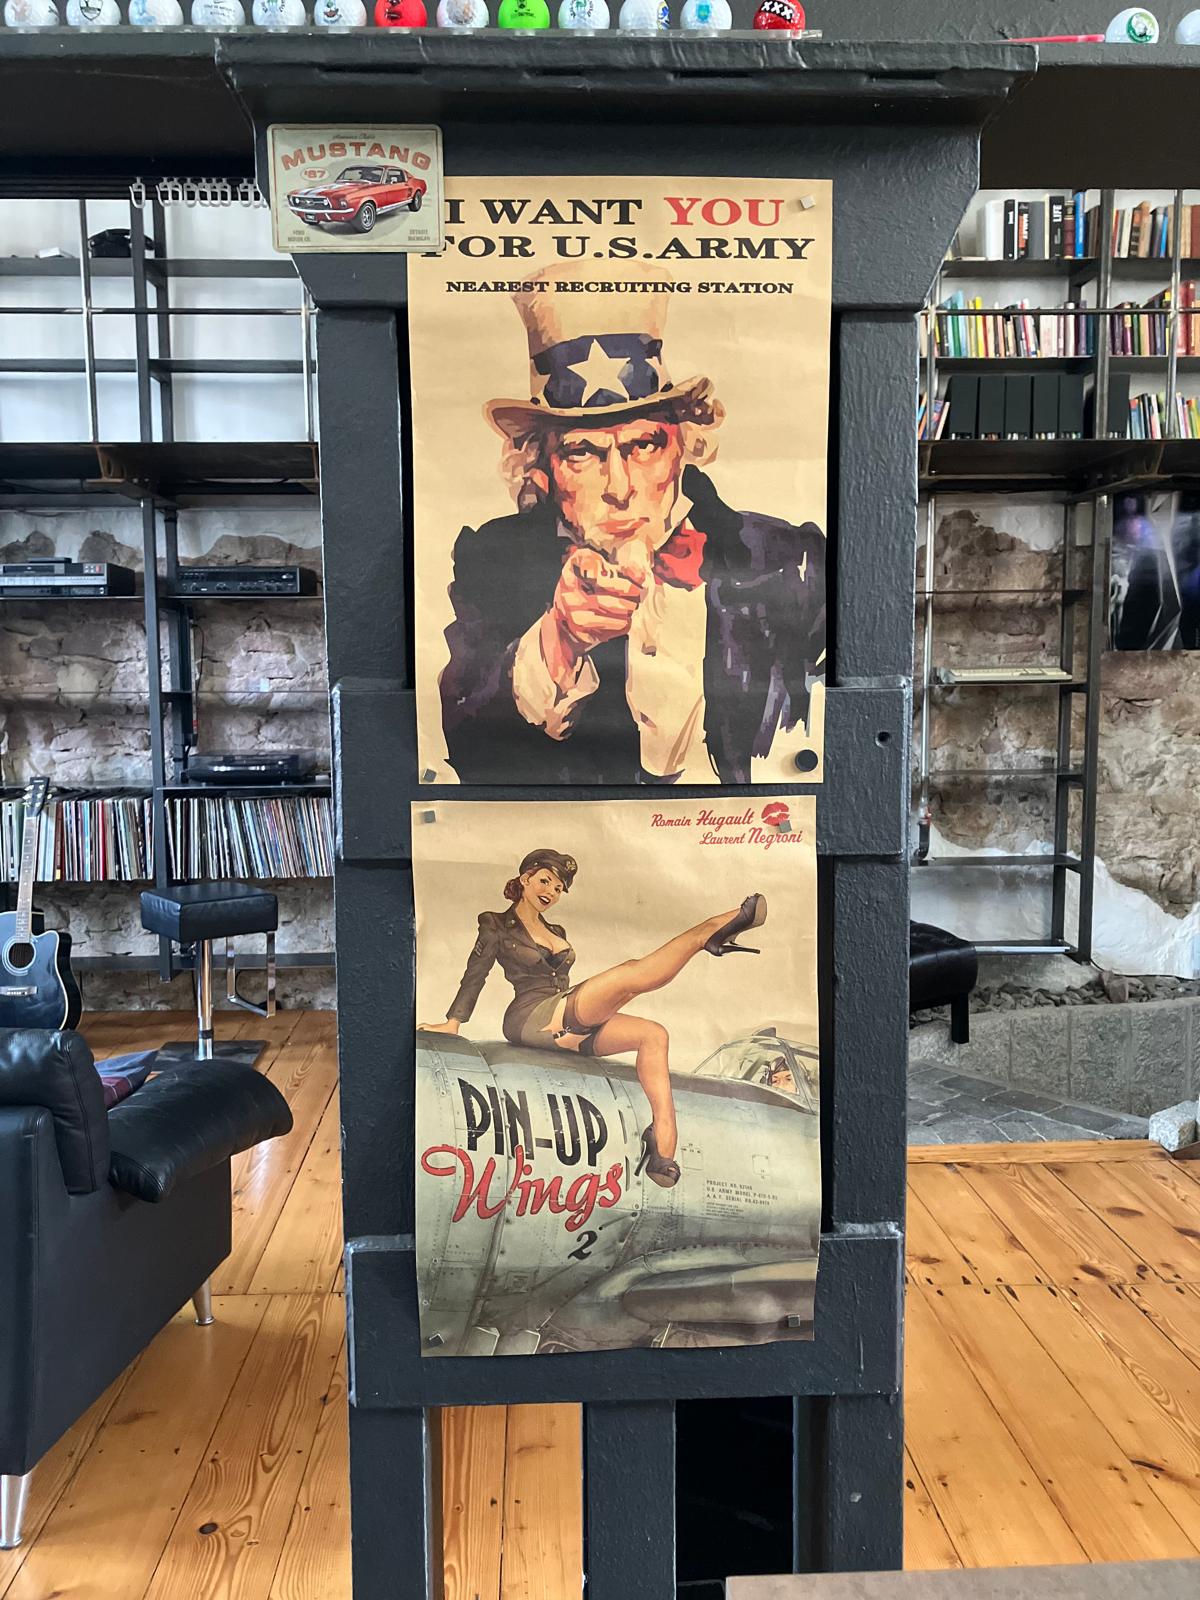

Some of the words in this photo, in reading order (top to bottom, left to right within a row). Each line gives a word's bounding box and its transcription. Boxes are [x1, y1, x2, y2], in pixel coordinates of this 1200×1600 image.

[281, 142, 432, 171] MUSTANG
[445, 198, 466, 224] I
[479, 198, 642, 225] WANT
[663, 197, 785, 226] YOU
[1053, 204, 1063, 222] LIFE
[446, 281, 550, 294] NEAREST
[554, 281, 692, 295] RECRUITING
[698, 281, 794, 294] STATION
[651, 813, 692, 828] Romain
[696, 808, 755, 832] Hugault
[699, 831, 746, 845] Laurent
[748, 827, 803, 850] Negroni
[457, 1077, 608, 1167] PIN-UP
[421, 1144, 623, 1232] Wings
[567, 1230, 598, 1260] 2
